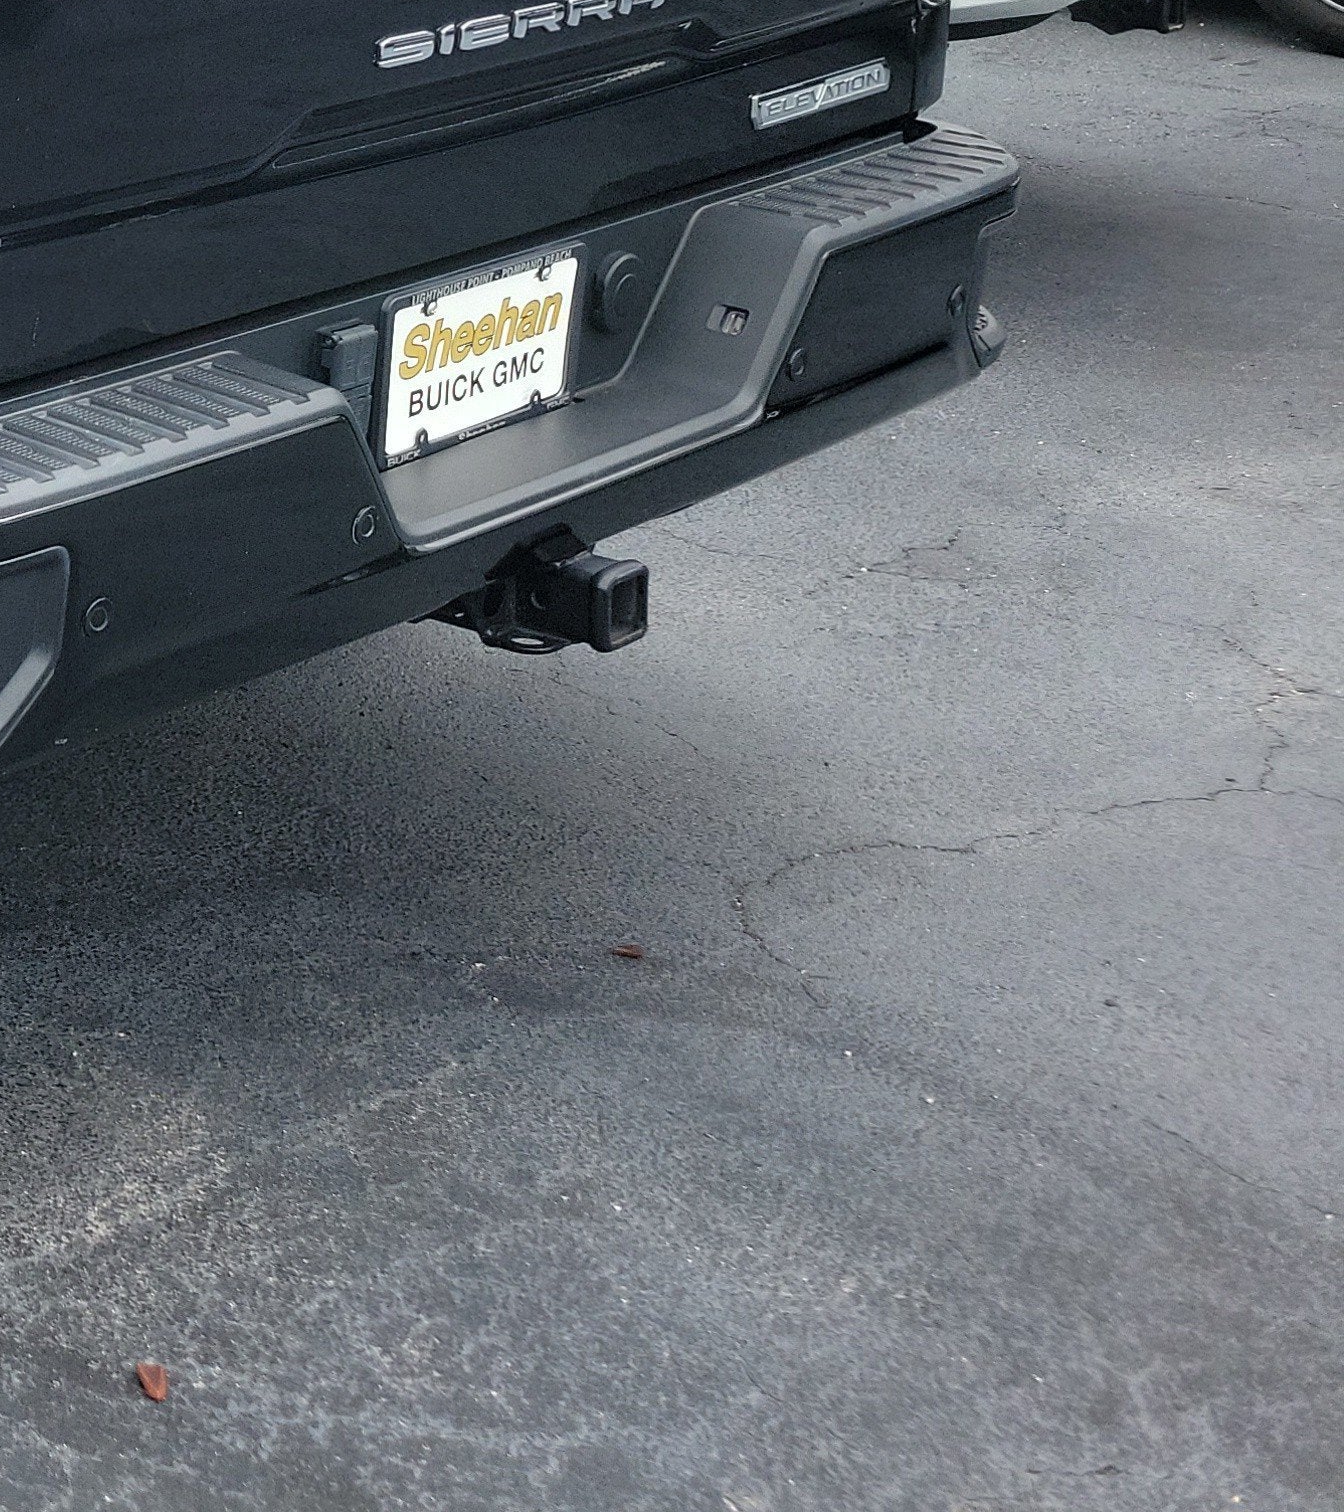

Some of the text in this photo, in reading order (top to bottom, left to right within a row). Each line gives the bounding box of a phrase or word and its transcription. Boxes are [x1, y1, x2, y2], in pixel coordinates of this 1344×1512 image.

[766, 69, 881, 117] ELEVATION
[412, 281, 466, 306] LIGHTHOUSE
[467, 272, 496, 288] POINT
[501, 258, 544, 279] POMPANO
[544, 249, 572, 266] BEACH
[399, 292, 563, 380] Sheehan
[408, 347, 545, 418] BUICK GMC
